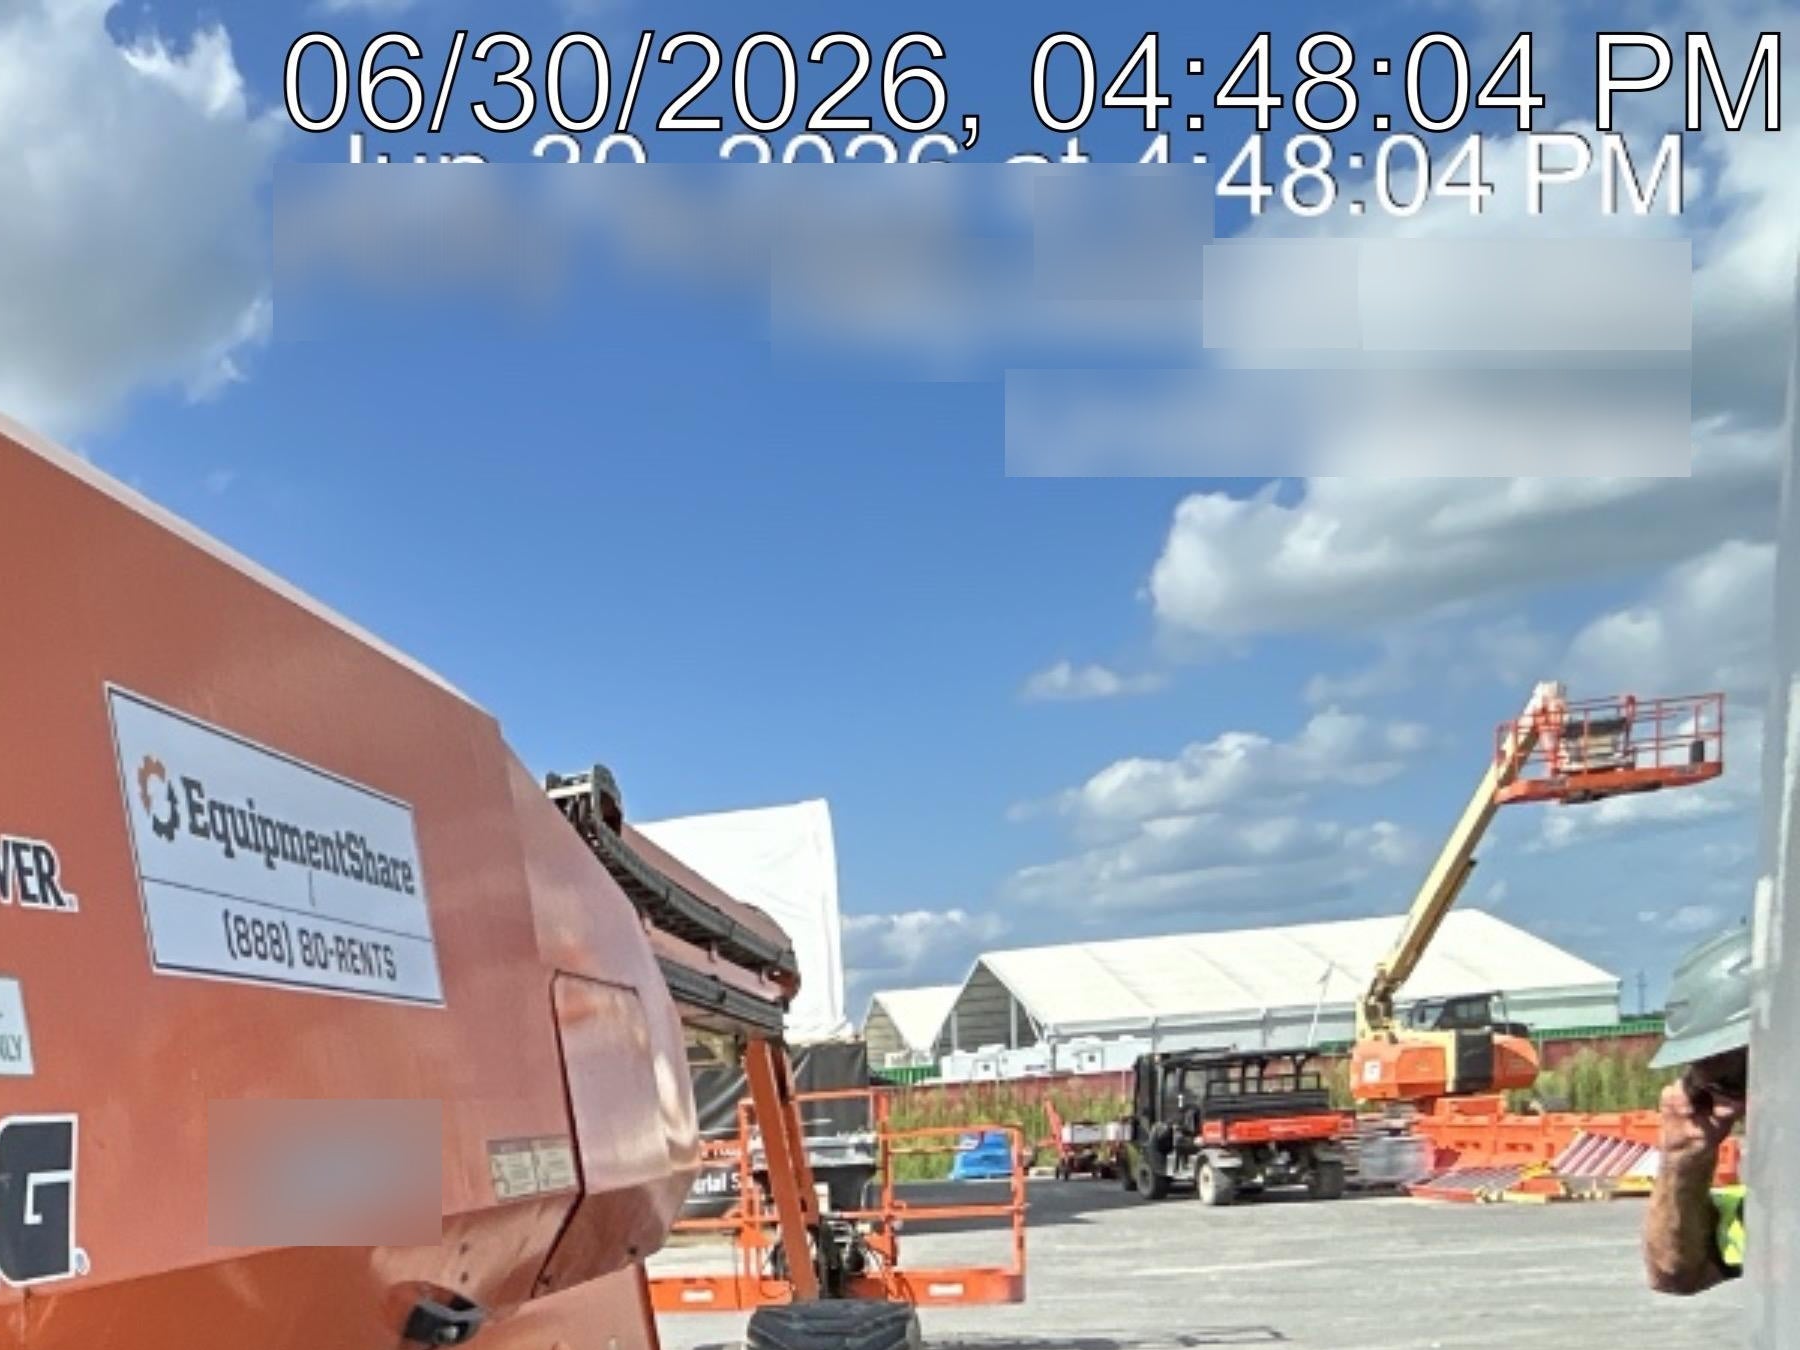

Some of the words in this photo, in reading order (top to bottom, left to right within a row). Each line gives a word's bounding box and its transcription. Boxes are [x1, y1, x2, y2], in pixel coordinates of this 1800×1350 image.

[181, 776, 415, 895] EquipmentShare
[223, 908, 295, 968] (888)
[298, 928, 398, 982] 80-RENTS
